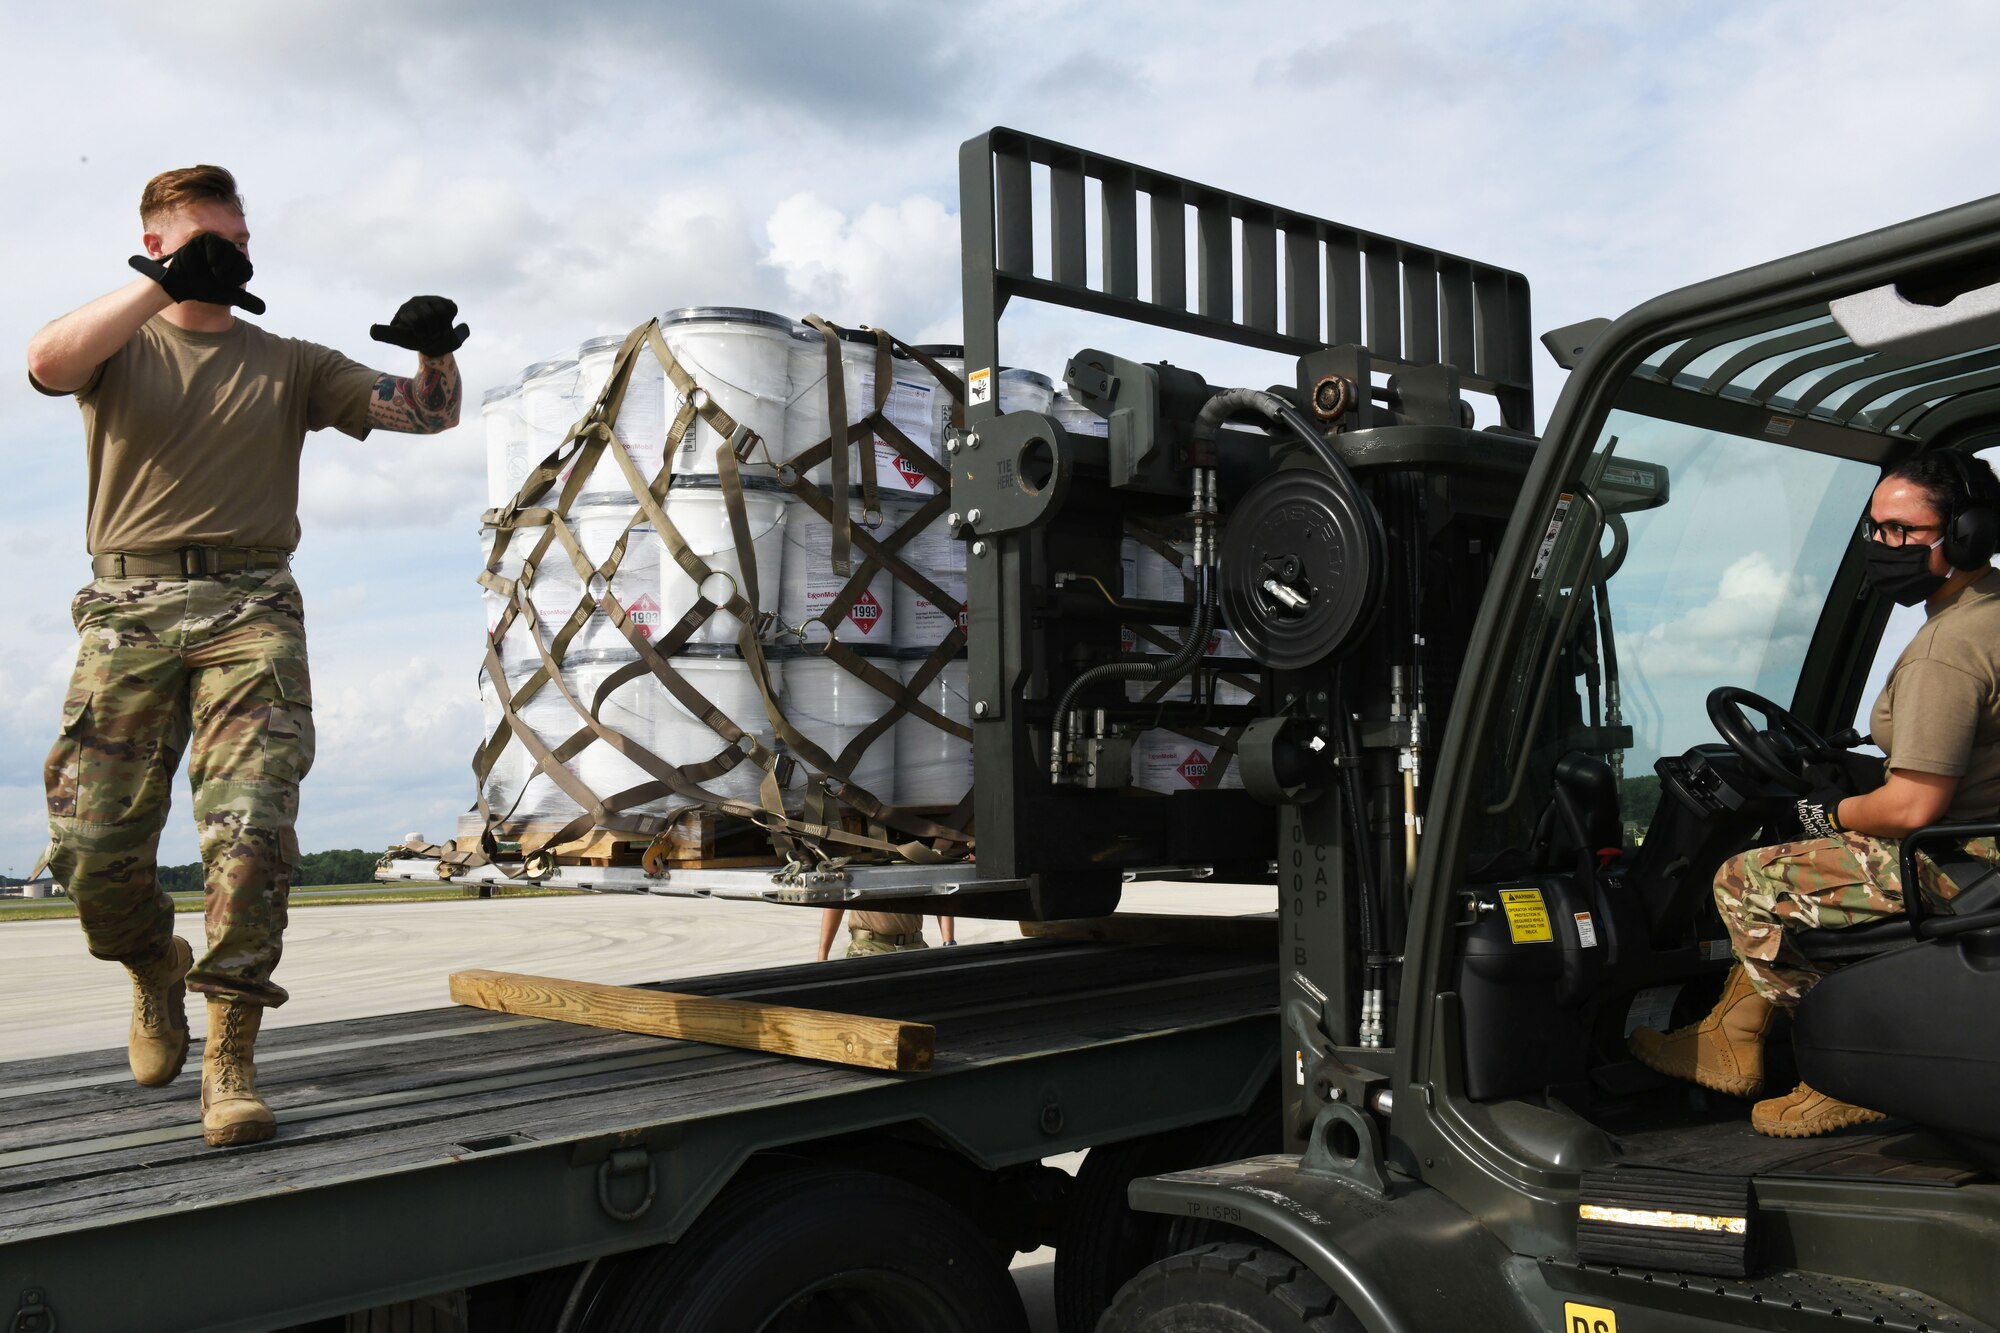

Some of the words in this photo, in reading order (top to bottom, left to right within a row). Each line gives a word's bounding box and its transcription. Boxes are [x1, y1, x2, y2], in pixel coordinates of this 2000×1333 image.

[996, 459, 1012, 474] TIE
[997, 474, 1014, 490] HERE
[632, 612, 658, 624] 1993
[853, 605, 876, 618] 1993
[1186, 765, 1208, 776] 1993
[1314, 844, 1328, 908] CAP
[1223, 1207, 1241, 1221] PSI
